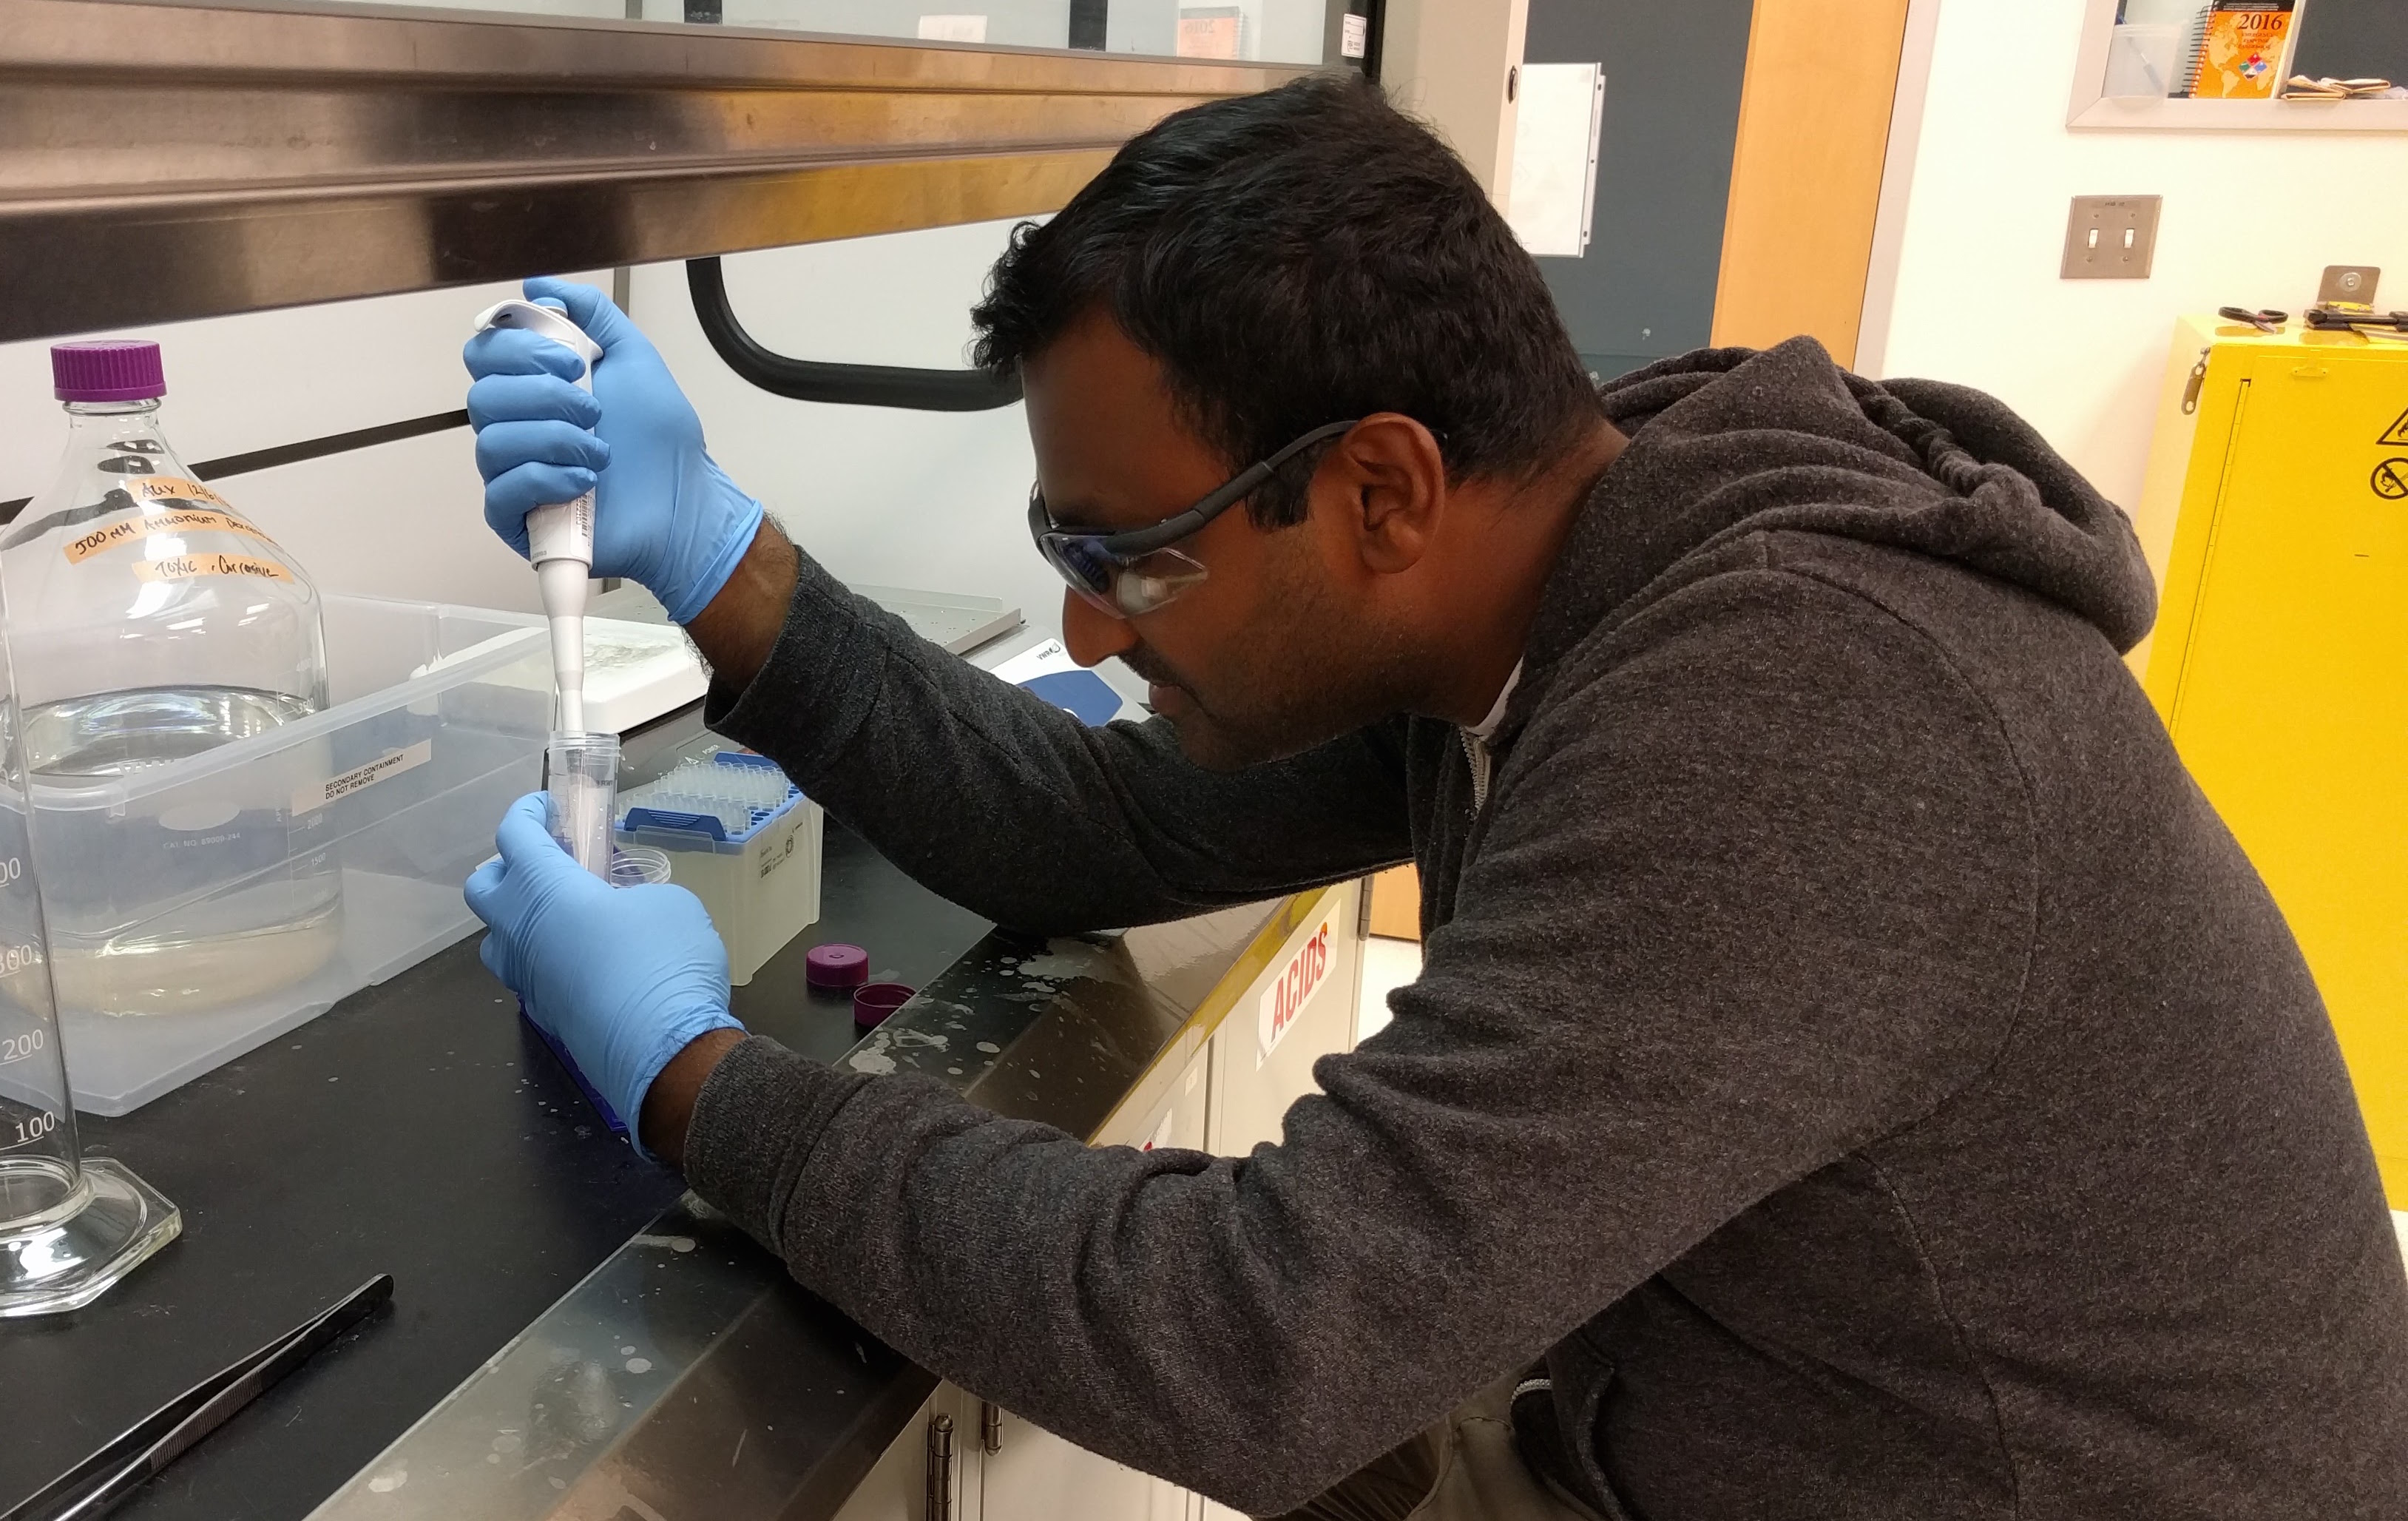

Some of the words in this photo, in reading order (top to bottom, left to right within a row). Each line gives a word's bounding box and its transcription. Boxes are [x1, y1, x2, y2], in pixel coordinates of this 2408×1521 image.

[2237, 13, 2284, 30] 2016
[1036, 650, 1052, 660] VWR
[325, 771, 362, 792] SECONDARY
[363, 754, 404, 776] CONTAINMENT
[325, 790, 334, 800] DO
[336, 785, 348, 795] NOT
[350, 774, 375, 789] REMOVE
[311, 852, 325, 866] 1500
[1271, 922, 1328, 1043] ACIDS
[2, 1029, 44, 1060] 200
[16, 1111, 55, 1142] 100
